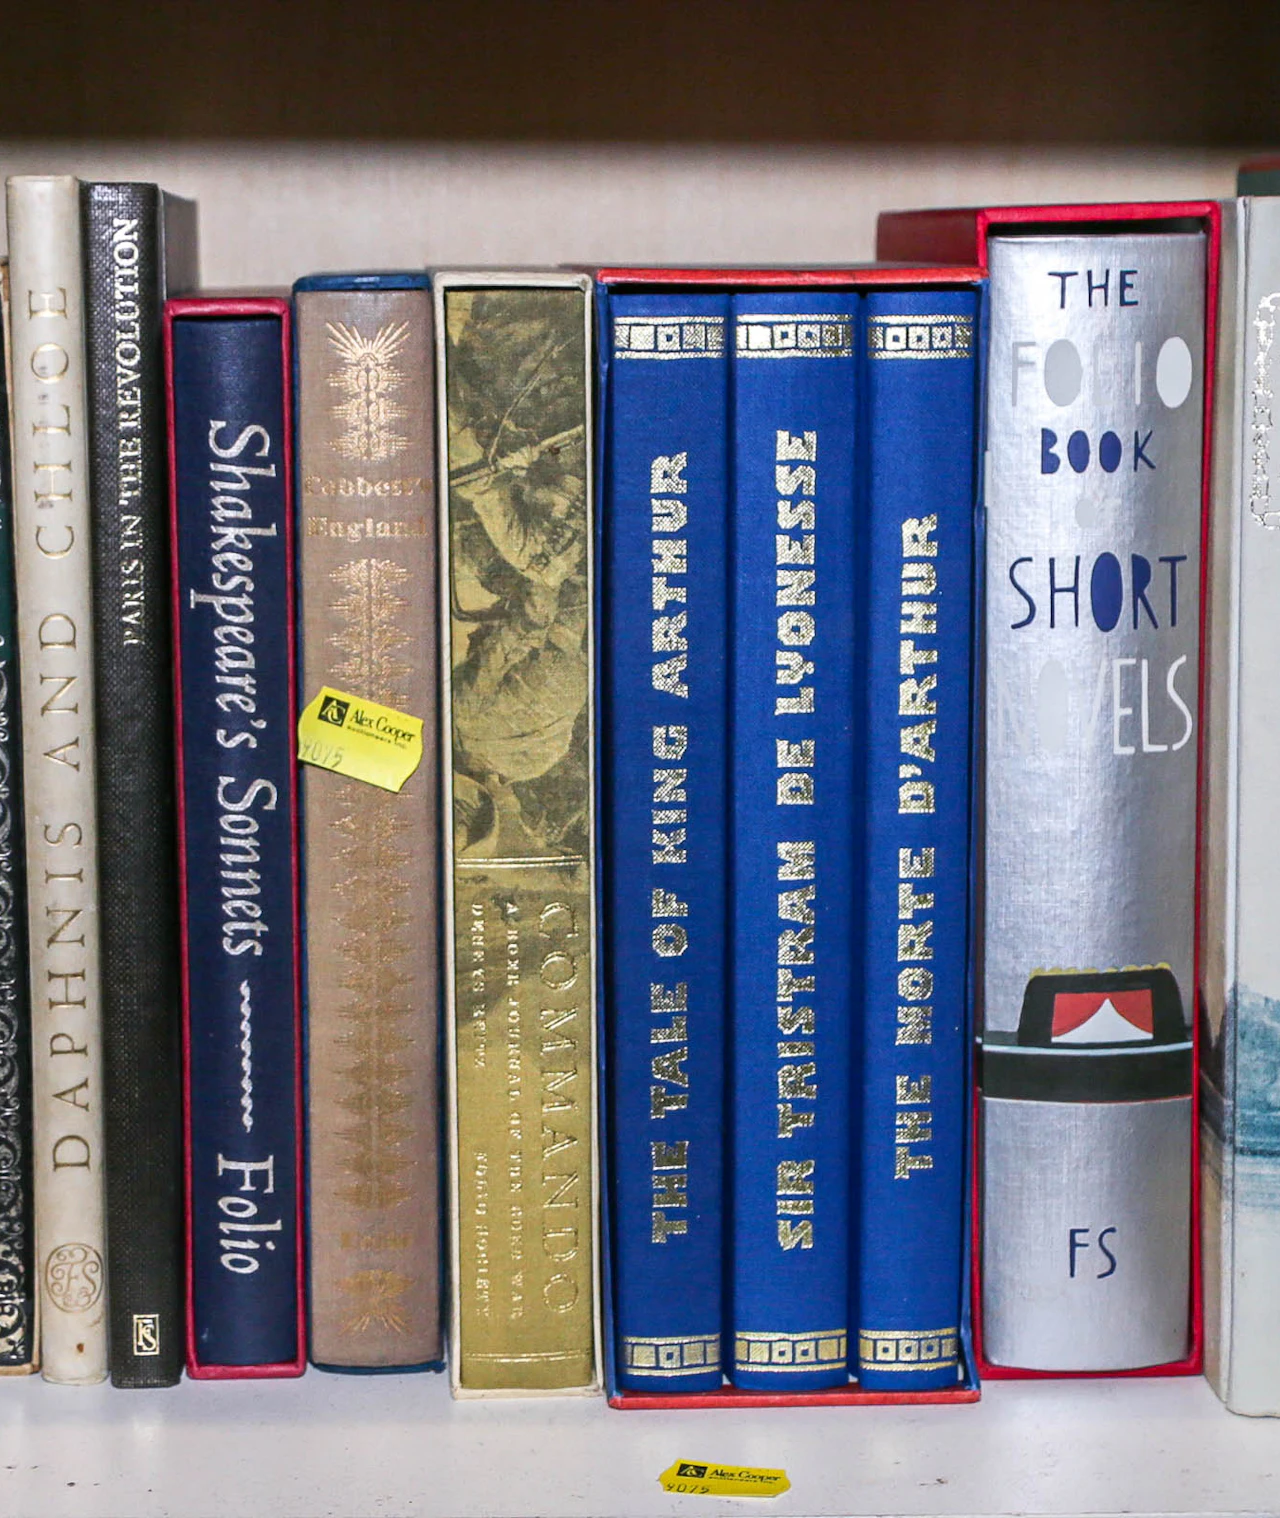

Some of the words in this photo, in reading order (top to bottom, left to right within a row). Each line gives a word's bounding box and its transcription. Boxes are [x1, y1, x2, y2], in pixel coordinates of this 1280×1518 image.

[113, 217, 143, 431] REVOLUTION
[1047, 269, 1140, 309] THE
[29, 288, 75, 559] CHLOE
[119, 438, 143, 505] THE
[1041, 427, 1156, 474] BOOK
[120, 514, 144, 546] IN
[190, 419, 277, 751] Shakespeare's
[651, 451, 688, 699] ARTHUR
[774, 429, 817, 716] LYONESSE
[1009, 551, 1188, 633] SHORT
[121, 552, 146, 645] PARIS
[40, 612, 80, 771] AND
[350, 709, 375, 728] Alex
[376, 717, 416, 743] Cooper
[898, 513, 939, 815] D'ARTHUR
[651, 724, 688, 864] KING
[776, 739, 815, 806] DE
[218, 775, 279, 957] Sonnets
[651, 889, 689, 958] OF
[44, 821, 91, 1172] DAPHNIS
[777, 841, 817, 1139] TRISTRAM
[895, 846, 936, 1046] MORTE
[539, 902, 580, 1314] COMMANDO
[651, 981, 689, 1119] TALE
[651, 1140, 689, 1243] THE
[894, 1075, 933, 1180] THE
[217, 1153, 282, 1274] Folio
[777, 1159, 815, 1252] SIR
[1068, 1226, 1118, 1279] FS
